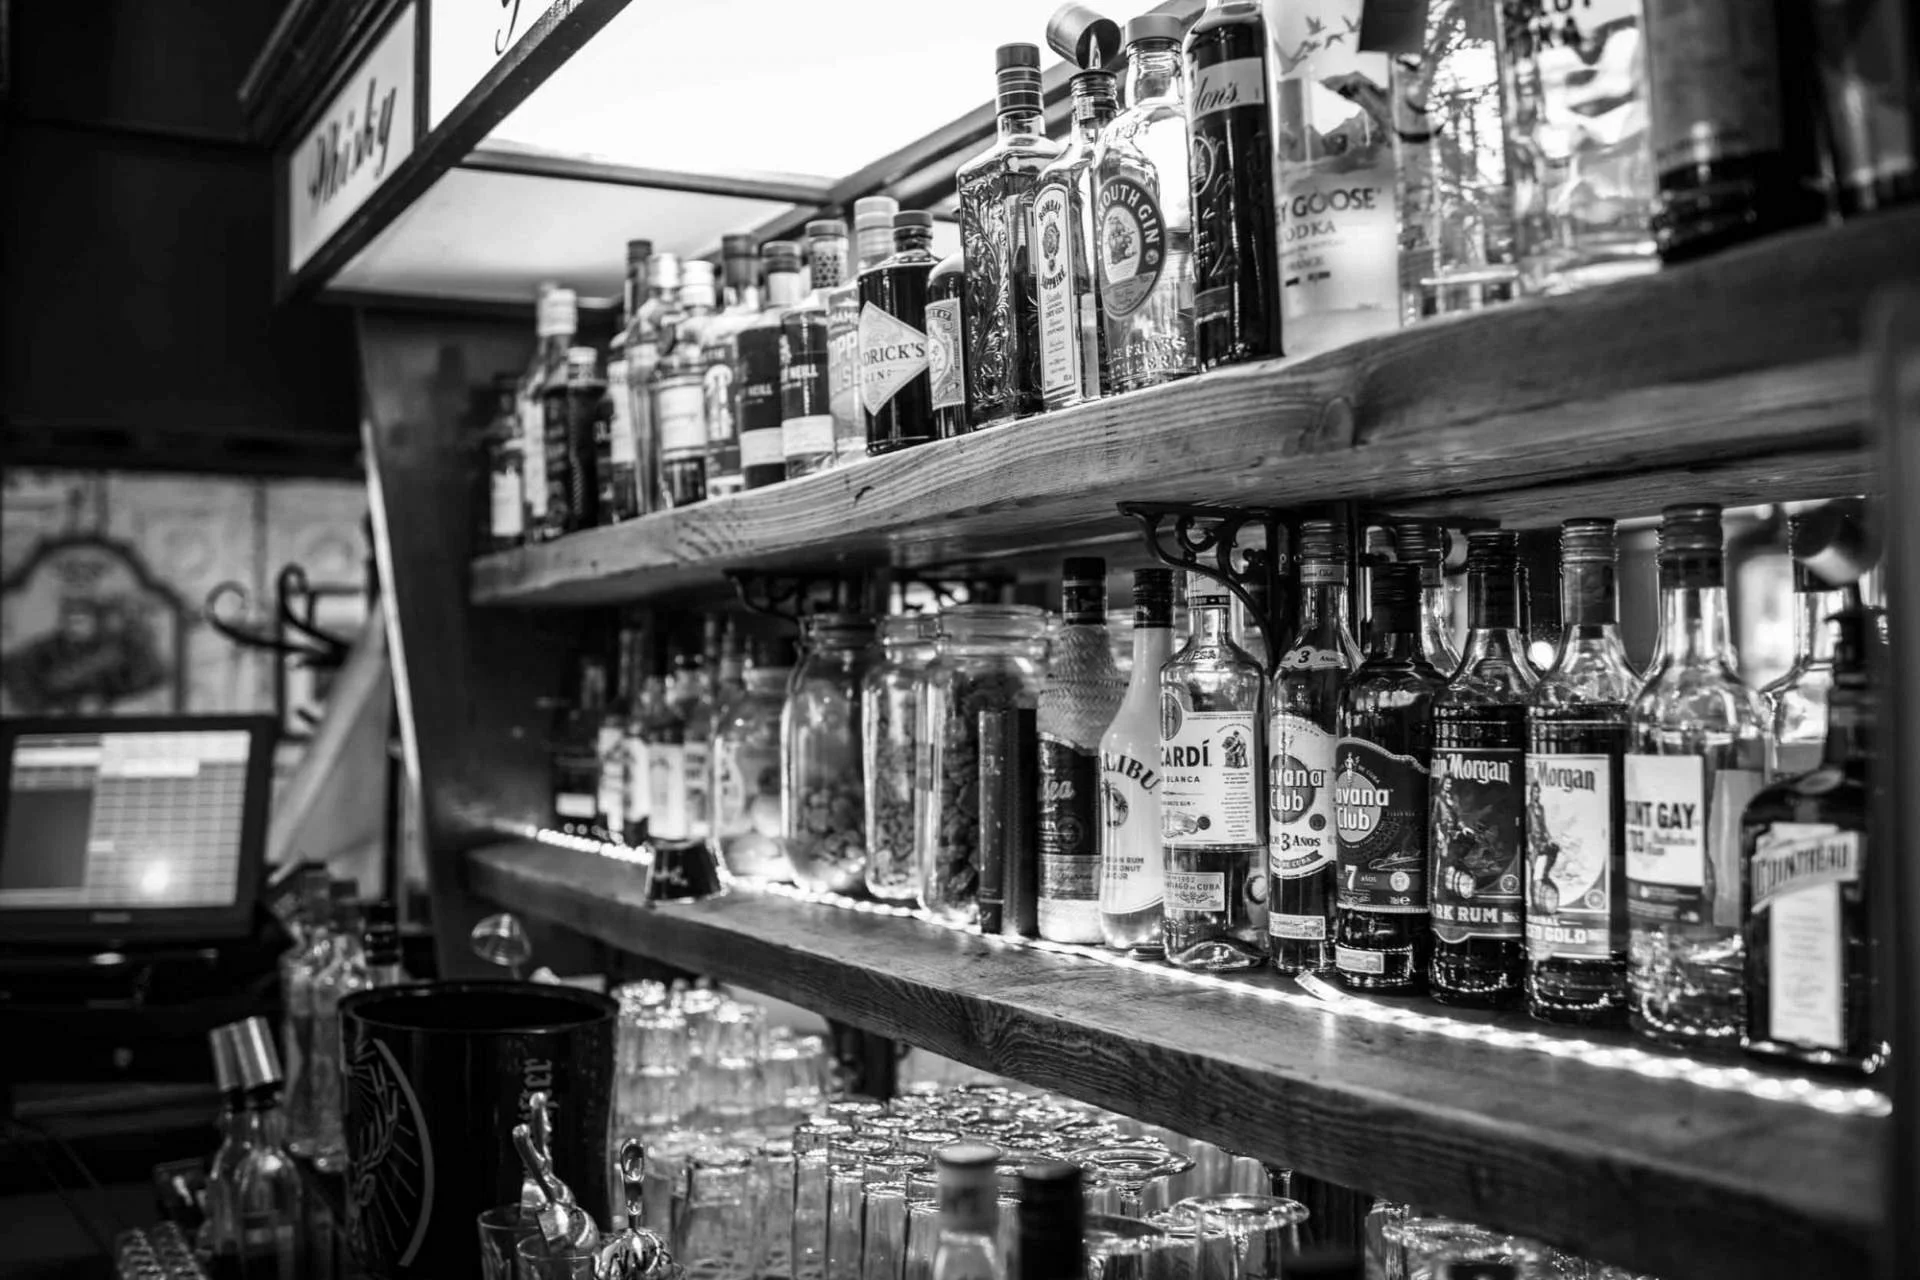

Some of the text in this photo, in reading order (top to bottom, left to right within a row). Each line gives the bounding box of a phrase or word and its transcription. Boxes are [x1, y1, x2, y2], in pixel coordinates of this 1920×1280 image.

[1292, 188, 1376, 217] GOOSE
[1138, 204, 1160, 244] GIN
[1298, 650, 1311, 664] 3
[1101, 751, 1159, 790] LIBU
[1446, 752, 1512, 784] Morgan
[1537, 761, 1596, 793] Morgan
[1270, 789, 1304, 811] Club
[1336, 807, 1370, 830] Club
[1657, 802, 1696, 830] GAY
[1280, 832, 1290, 851] 3
[1197, 883, 1220, 891] CUBA
[1345, 864, 1358, 890] 7
[1457, 906, 1498, 923] RUM
[1545, 926, 1588, 944] GOLD
